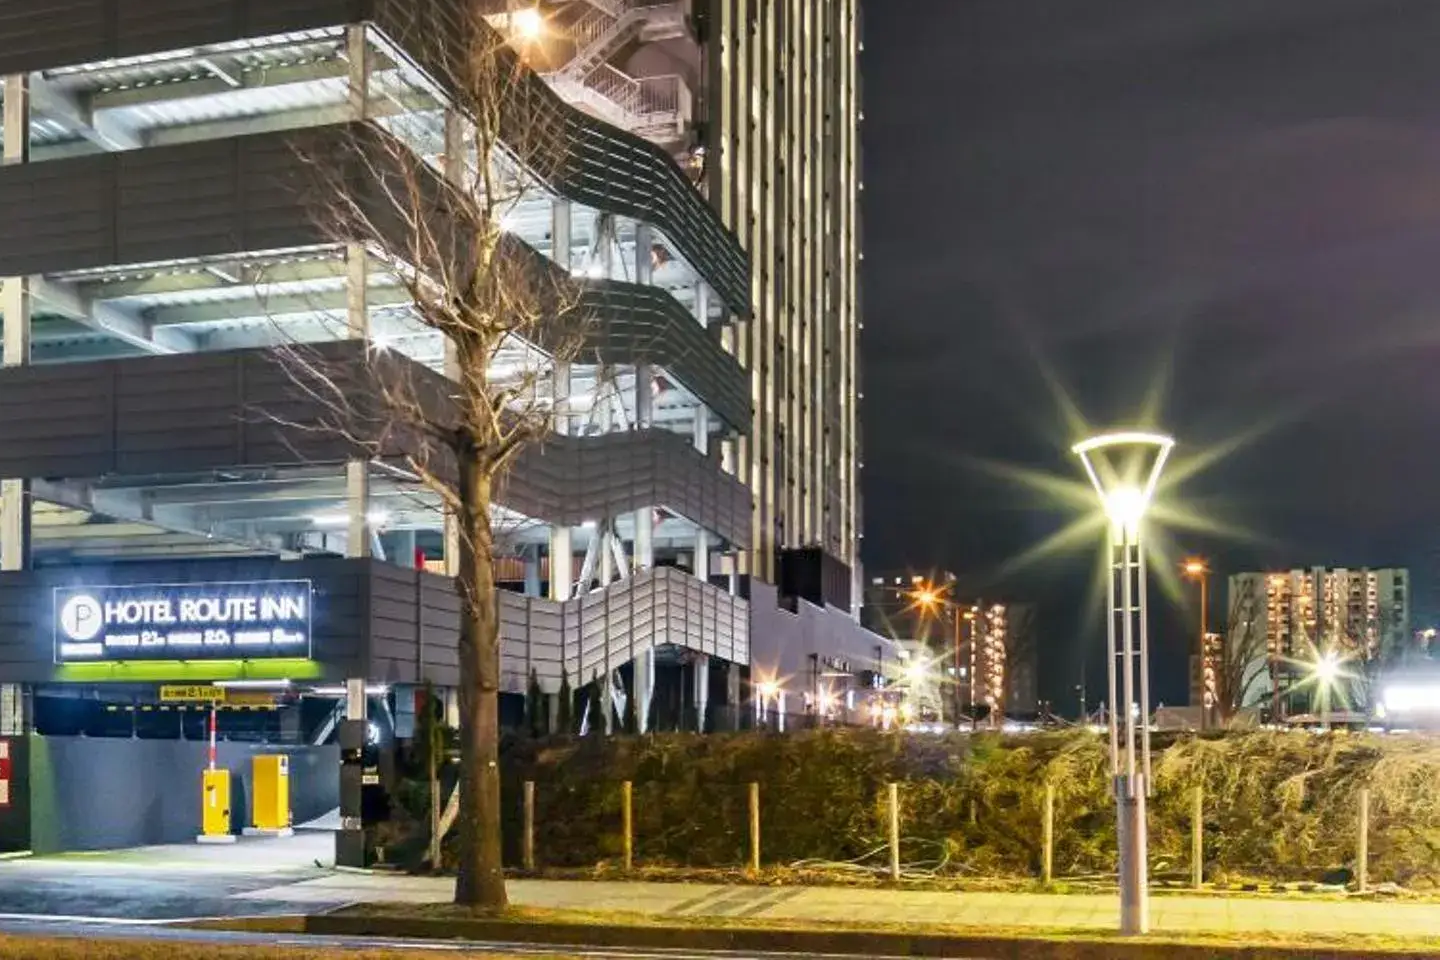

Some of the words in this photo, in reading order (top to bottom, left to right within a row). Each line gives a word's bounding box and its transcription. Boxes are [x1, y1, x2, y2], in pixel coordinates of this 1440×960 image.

[105, 600, 176, 624] HOTEL
[179, 598, 257, 622] ROUTE
[260, 595, 305, 620] INN
